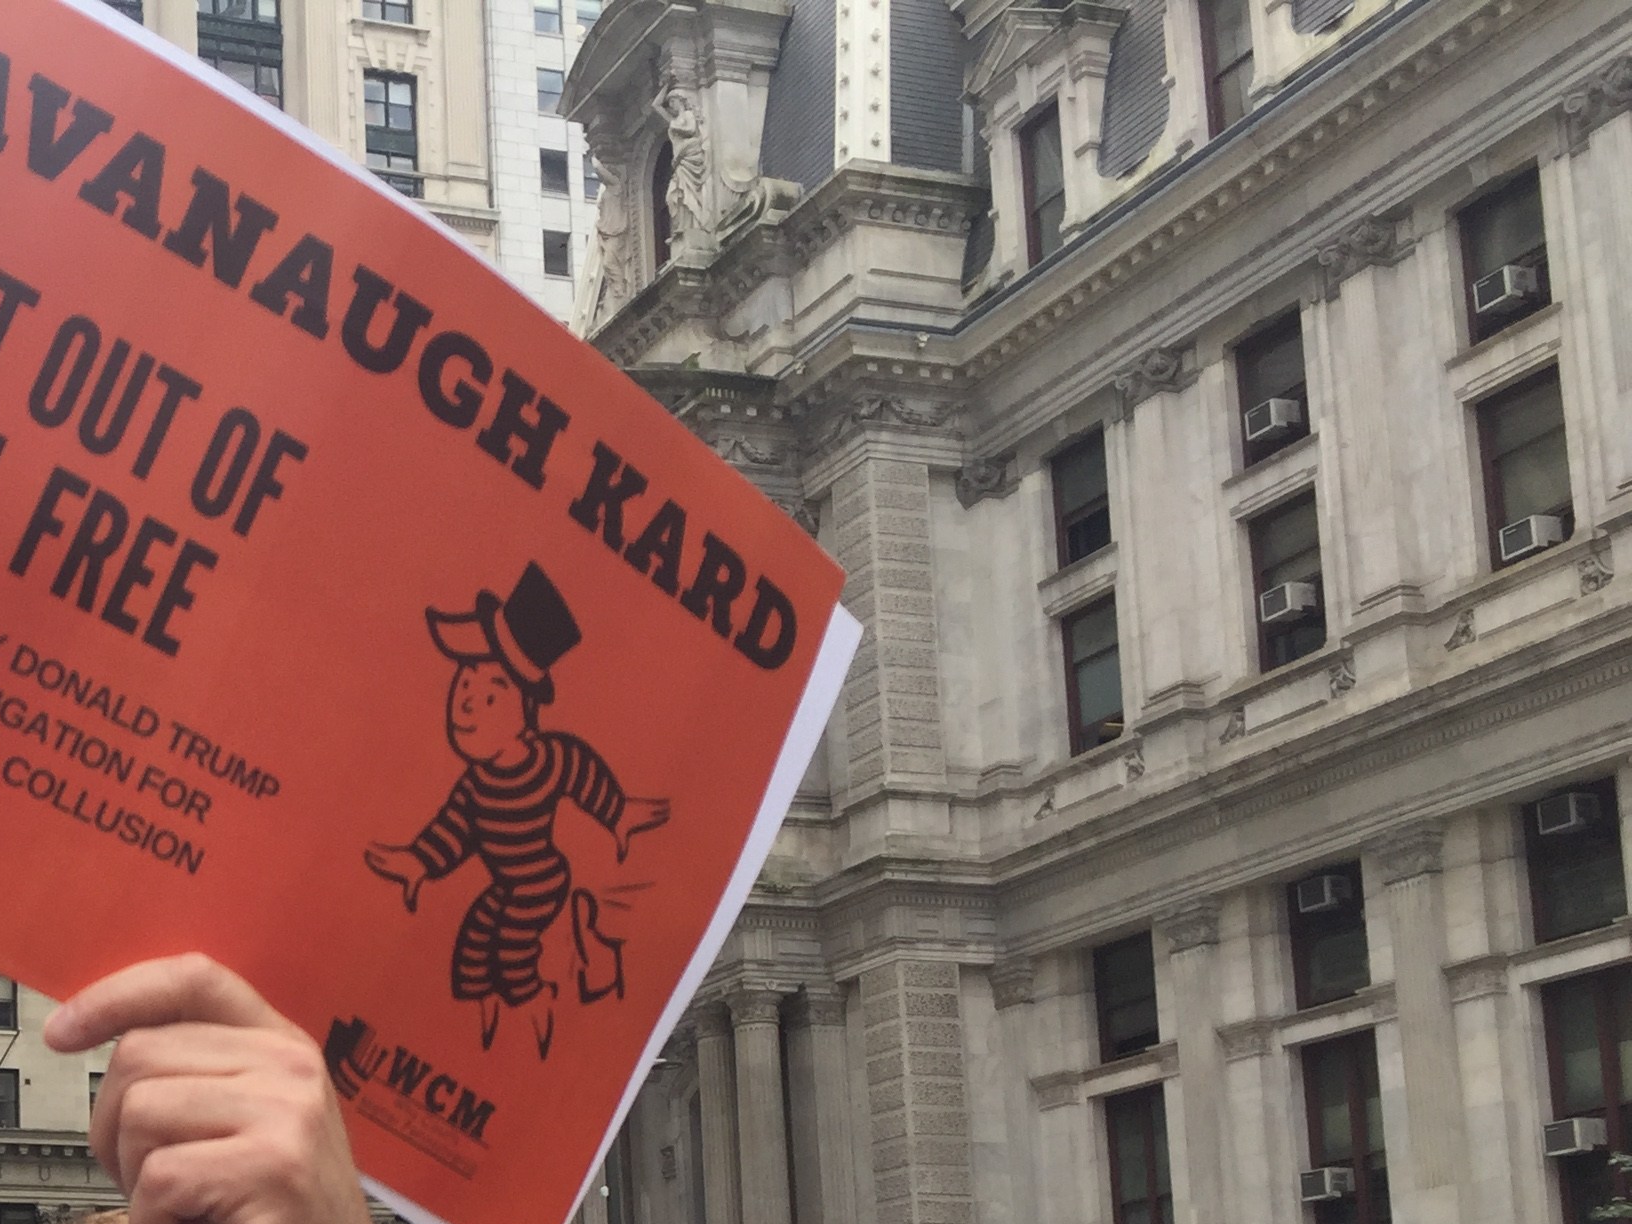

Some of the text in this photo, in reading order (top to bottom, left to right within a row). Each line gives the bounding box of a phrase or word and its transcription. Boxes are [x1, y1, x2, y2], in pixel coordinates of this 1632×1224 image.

[28, 315, 204, 480] OUT
[191, 407, 309, 537] OF
[8, 465, 220, 657] FREE
[568, 440, 799, 671] KARD
[10, 644, 161, 738] DONALD
[171, 720, 281, 800] TRUMP
[137, 764, 212, 824] FOR
[2, 755, 204, 875] COLLUSION
[387, 1045, 496, 1141] WCM
